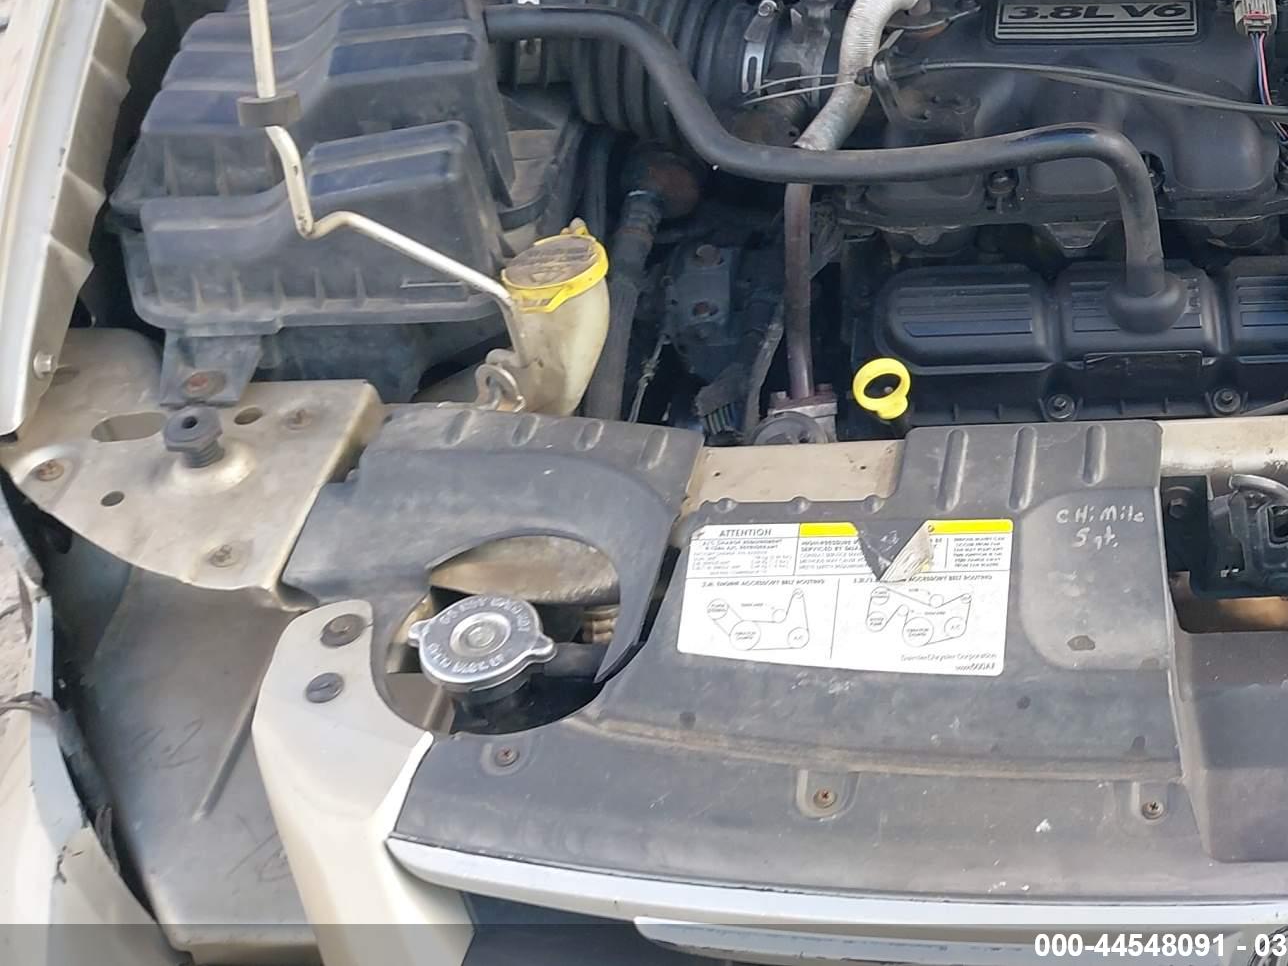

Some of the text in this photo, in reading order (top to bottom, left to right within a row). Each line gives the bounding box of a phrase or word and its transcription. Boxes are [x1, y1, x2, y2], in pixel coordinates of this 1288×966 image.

[1008, 3, 1187, 19] 3.8L V6
[719, 528, 772, 537] ATTENTION
